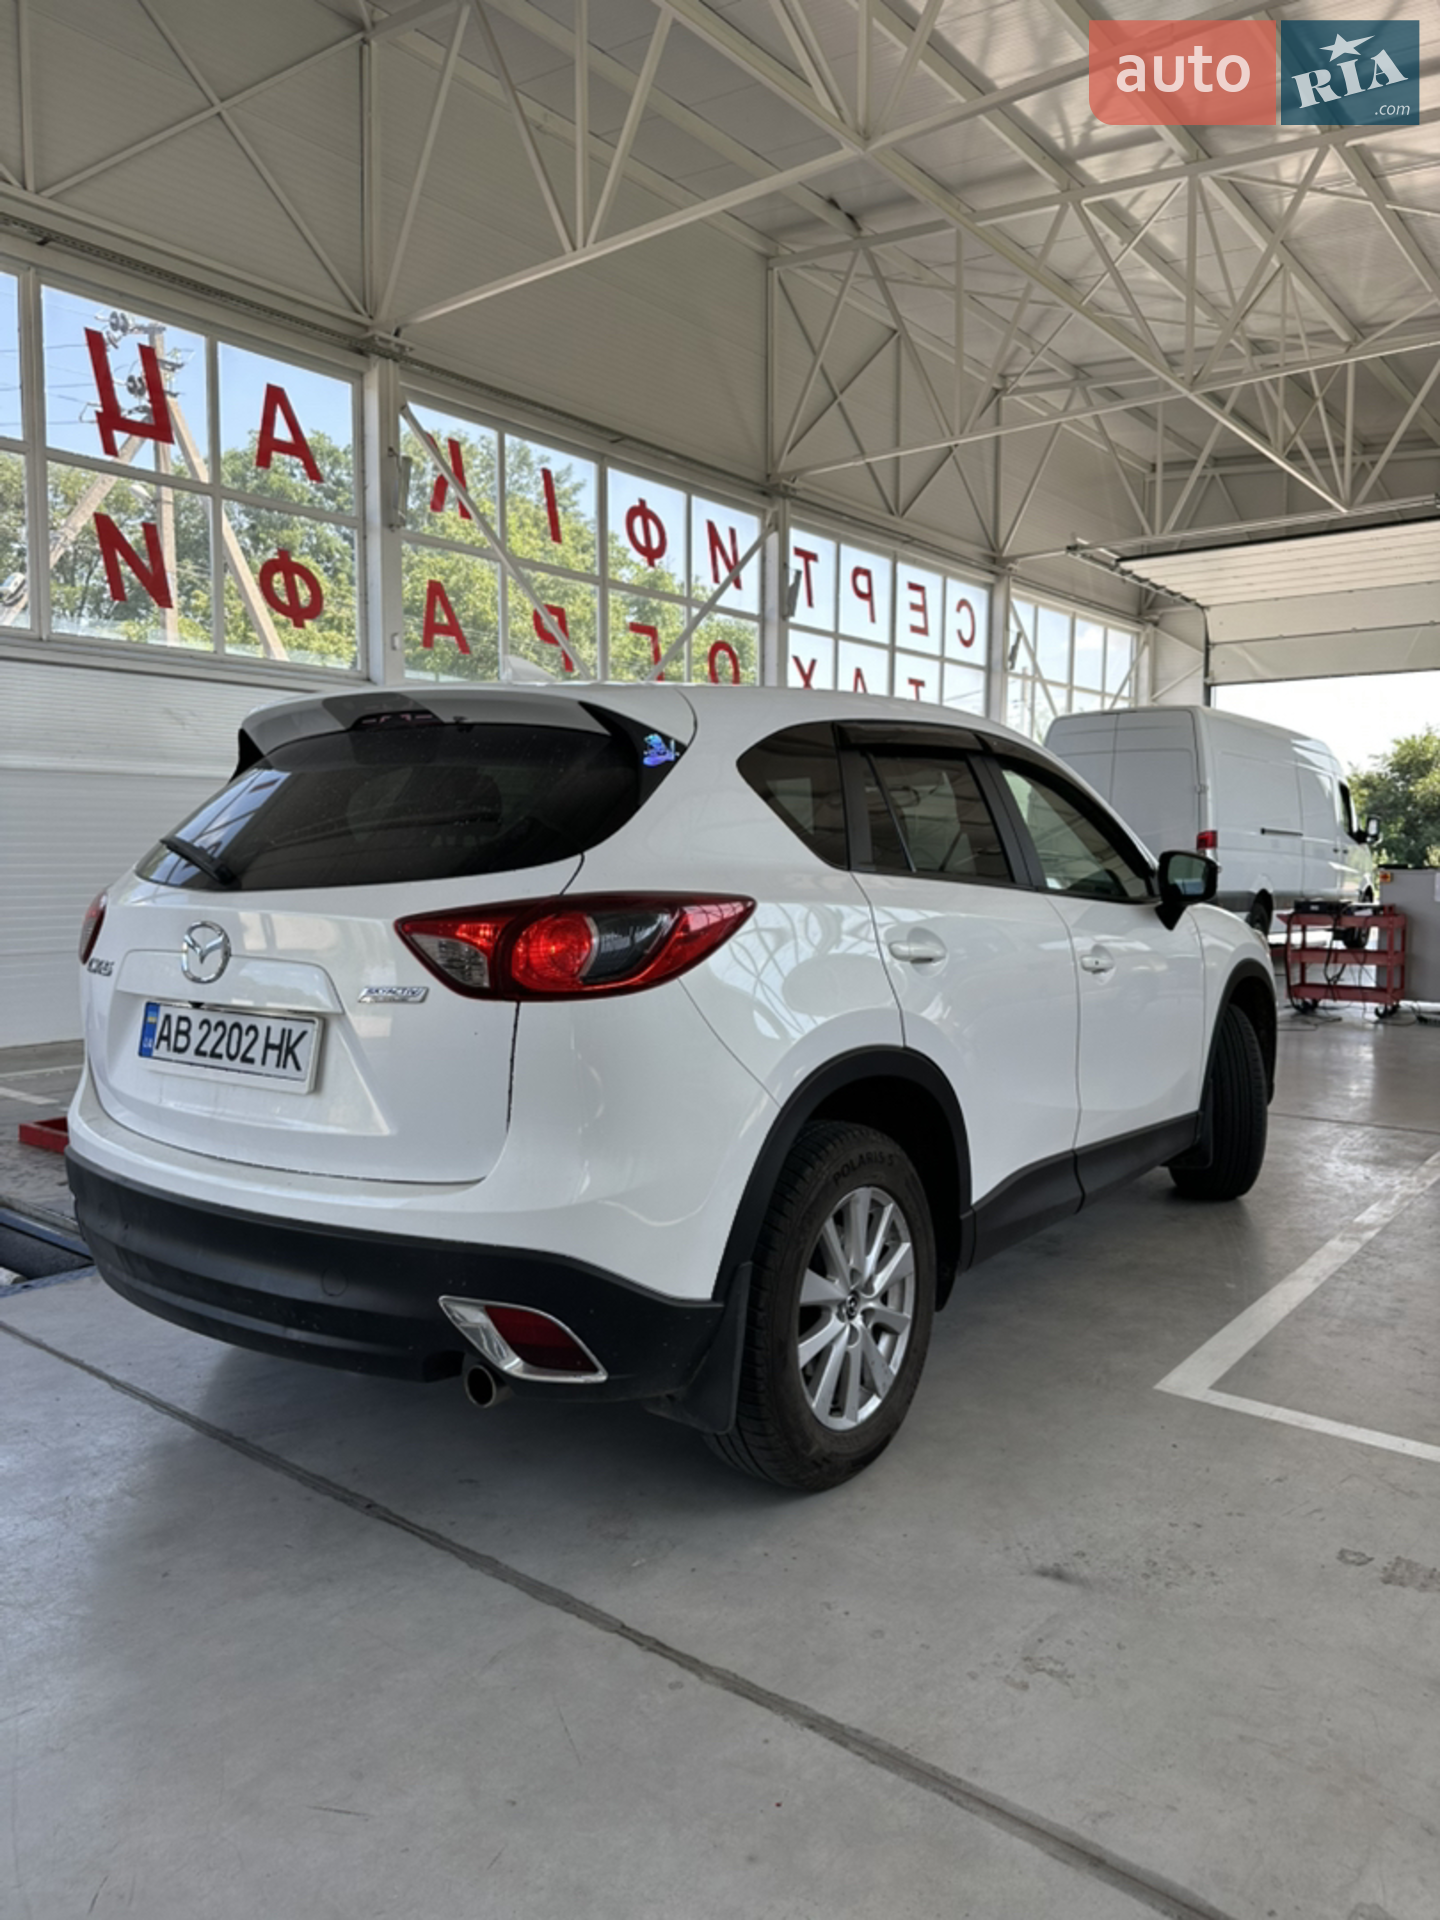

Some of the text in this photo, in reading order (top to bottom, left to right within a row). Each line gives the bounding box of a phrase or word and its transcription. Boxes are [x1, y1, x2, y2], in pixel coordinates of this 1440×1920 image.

[155, 1014, 308, 1071] AB 2202 HK
[833, 1152, 885, 1186] POLARIS
